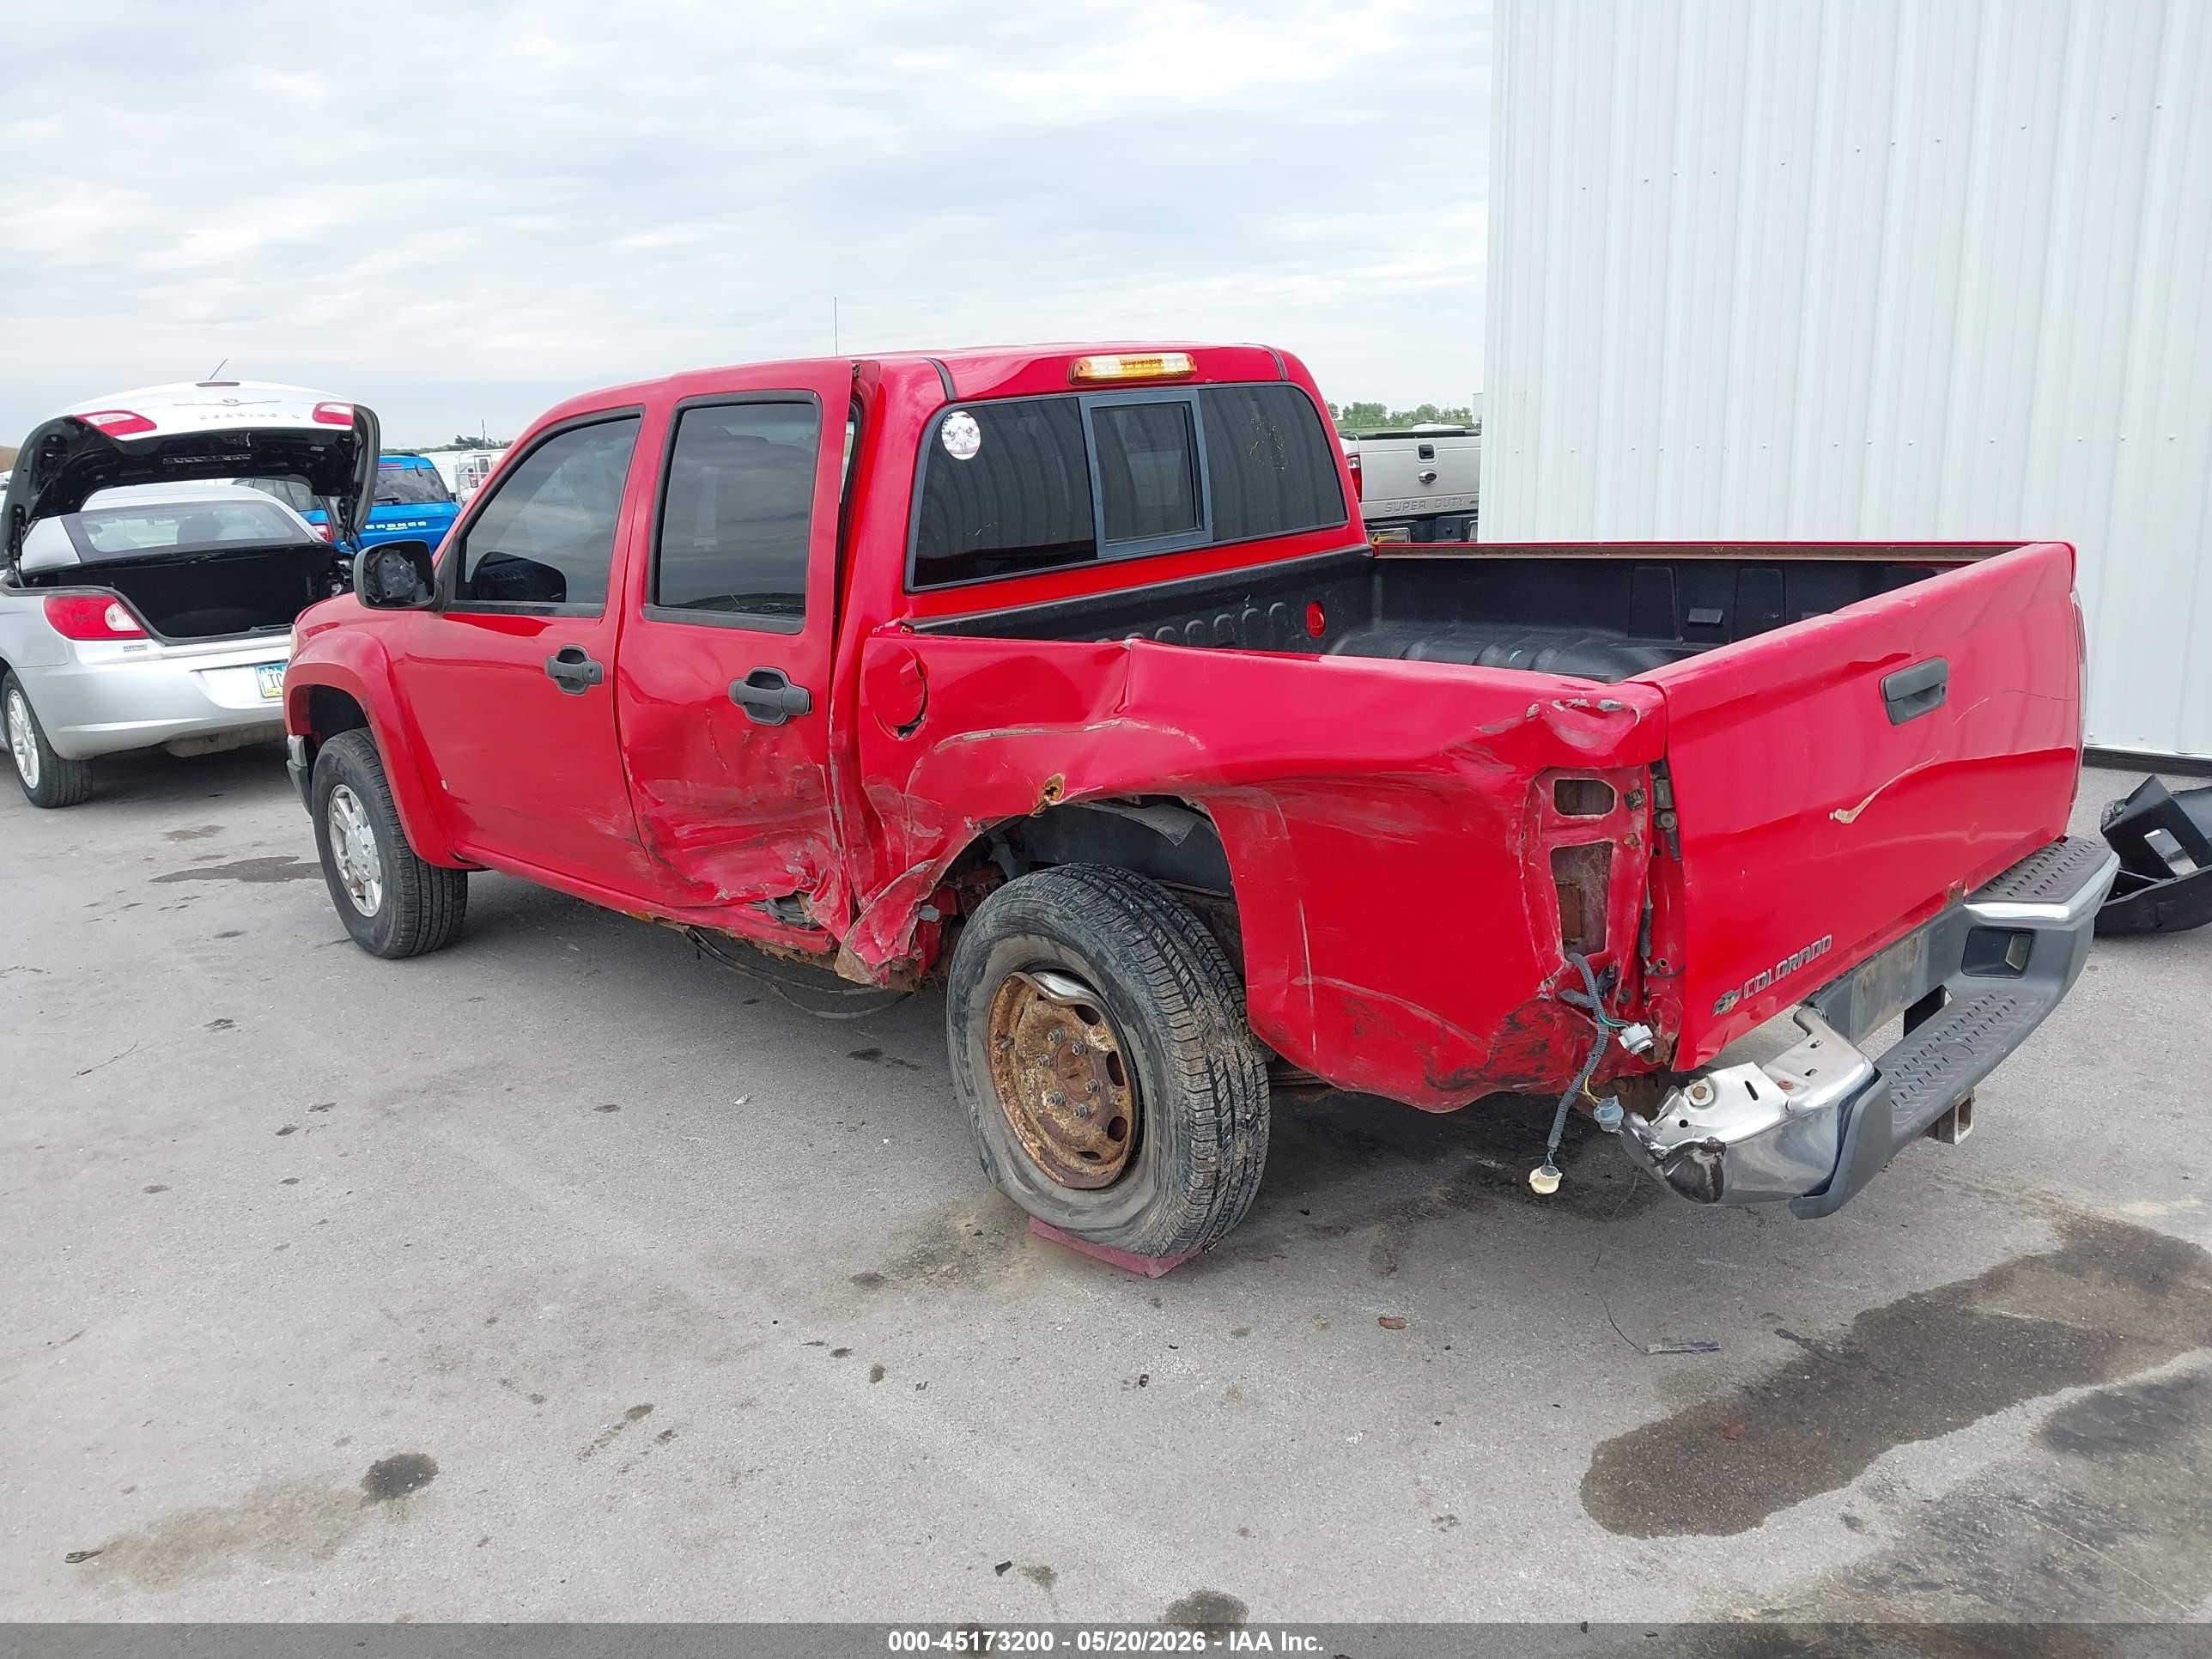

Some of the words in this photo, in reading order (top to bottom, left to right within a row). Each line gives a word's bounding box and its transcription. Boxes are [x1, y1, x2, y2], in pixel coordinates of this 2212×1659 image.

[1384, 500, 1426, 514] SUPER
[1434, 496, 1466, 510] DUTY
[1743, 933, 1832, 1000] COLORADO
